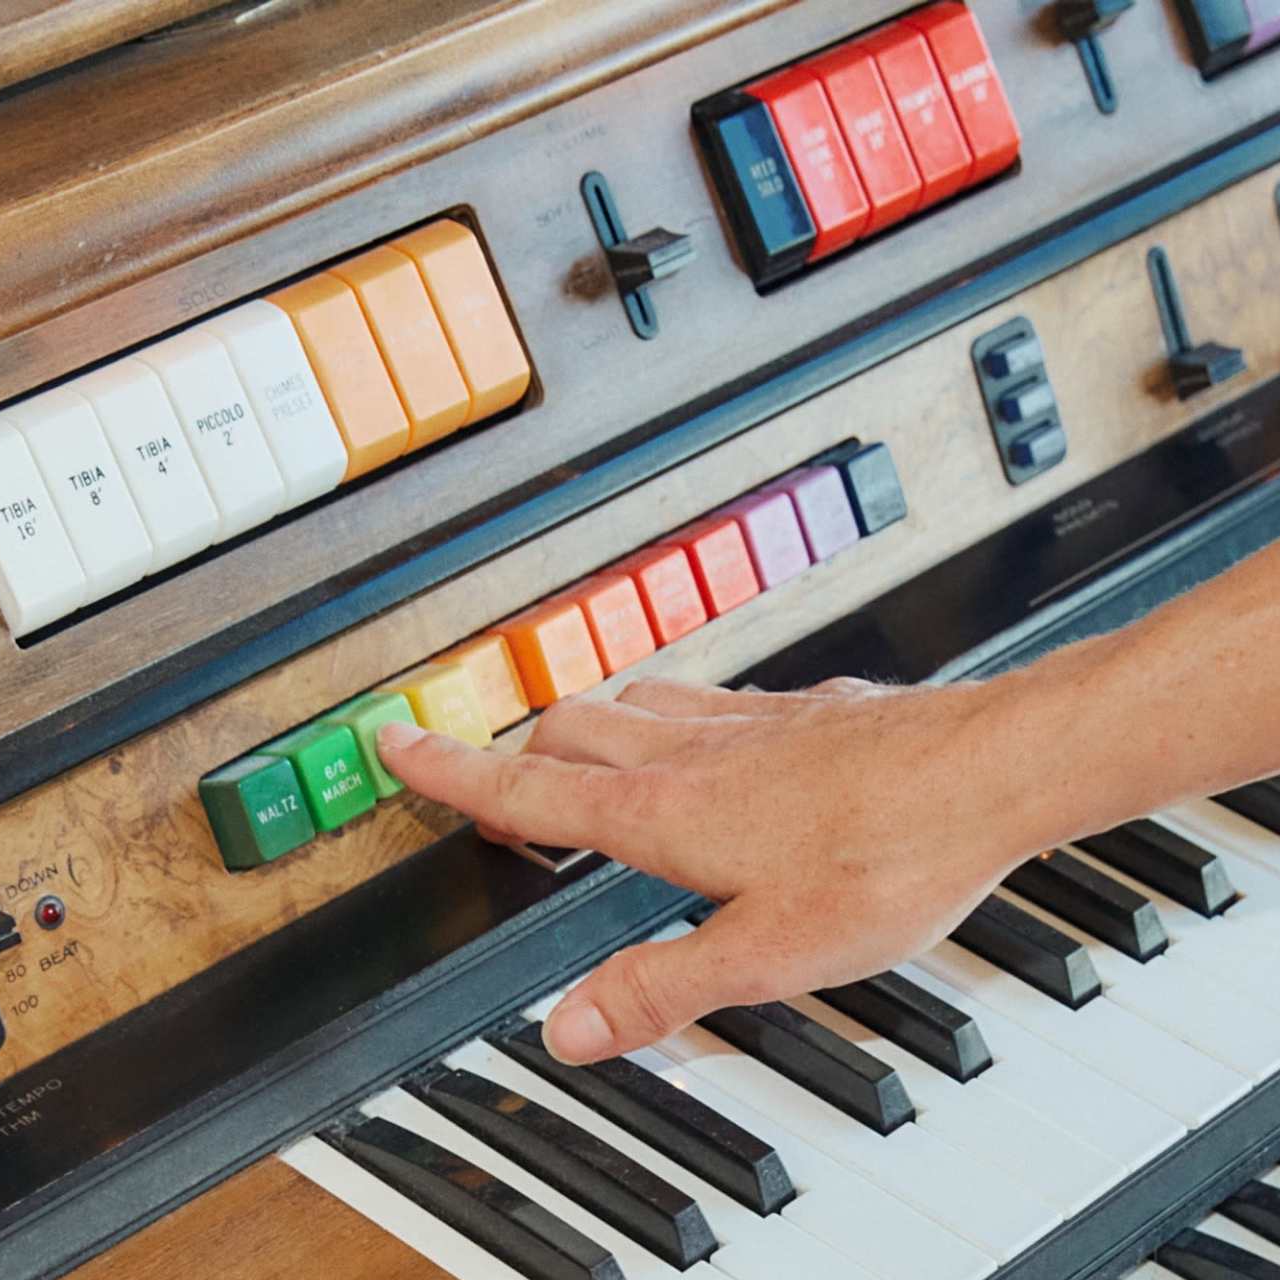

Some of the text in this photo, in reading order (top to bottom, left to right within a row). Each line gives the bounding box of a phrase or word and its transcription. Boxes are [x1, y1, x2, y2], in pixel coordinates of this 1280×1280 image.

[195, 402, 245, 435] PICCOLO
[135, 436, 172, 463] TIBIA
[68, 465, 106, 492] TIBIA
[0, 497, 38, 524] TIBIA
[322, 773, 363, 803] MARCH
[256, 794, 299, 825] WALTZ
[4, 862, 59, 900] DOWN
[38, 939, 81, 973] BEAT
[5, 964, 27, 984] 80
[10, 994, 40, 1017] 100
